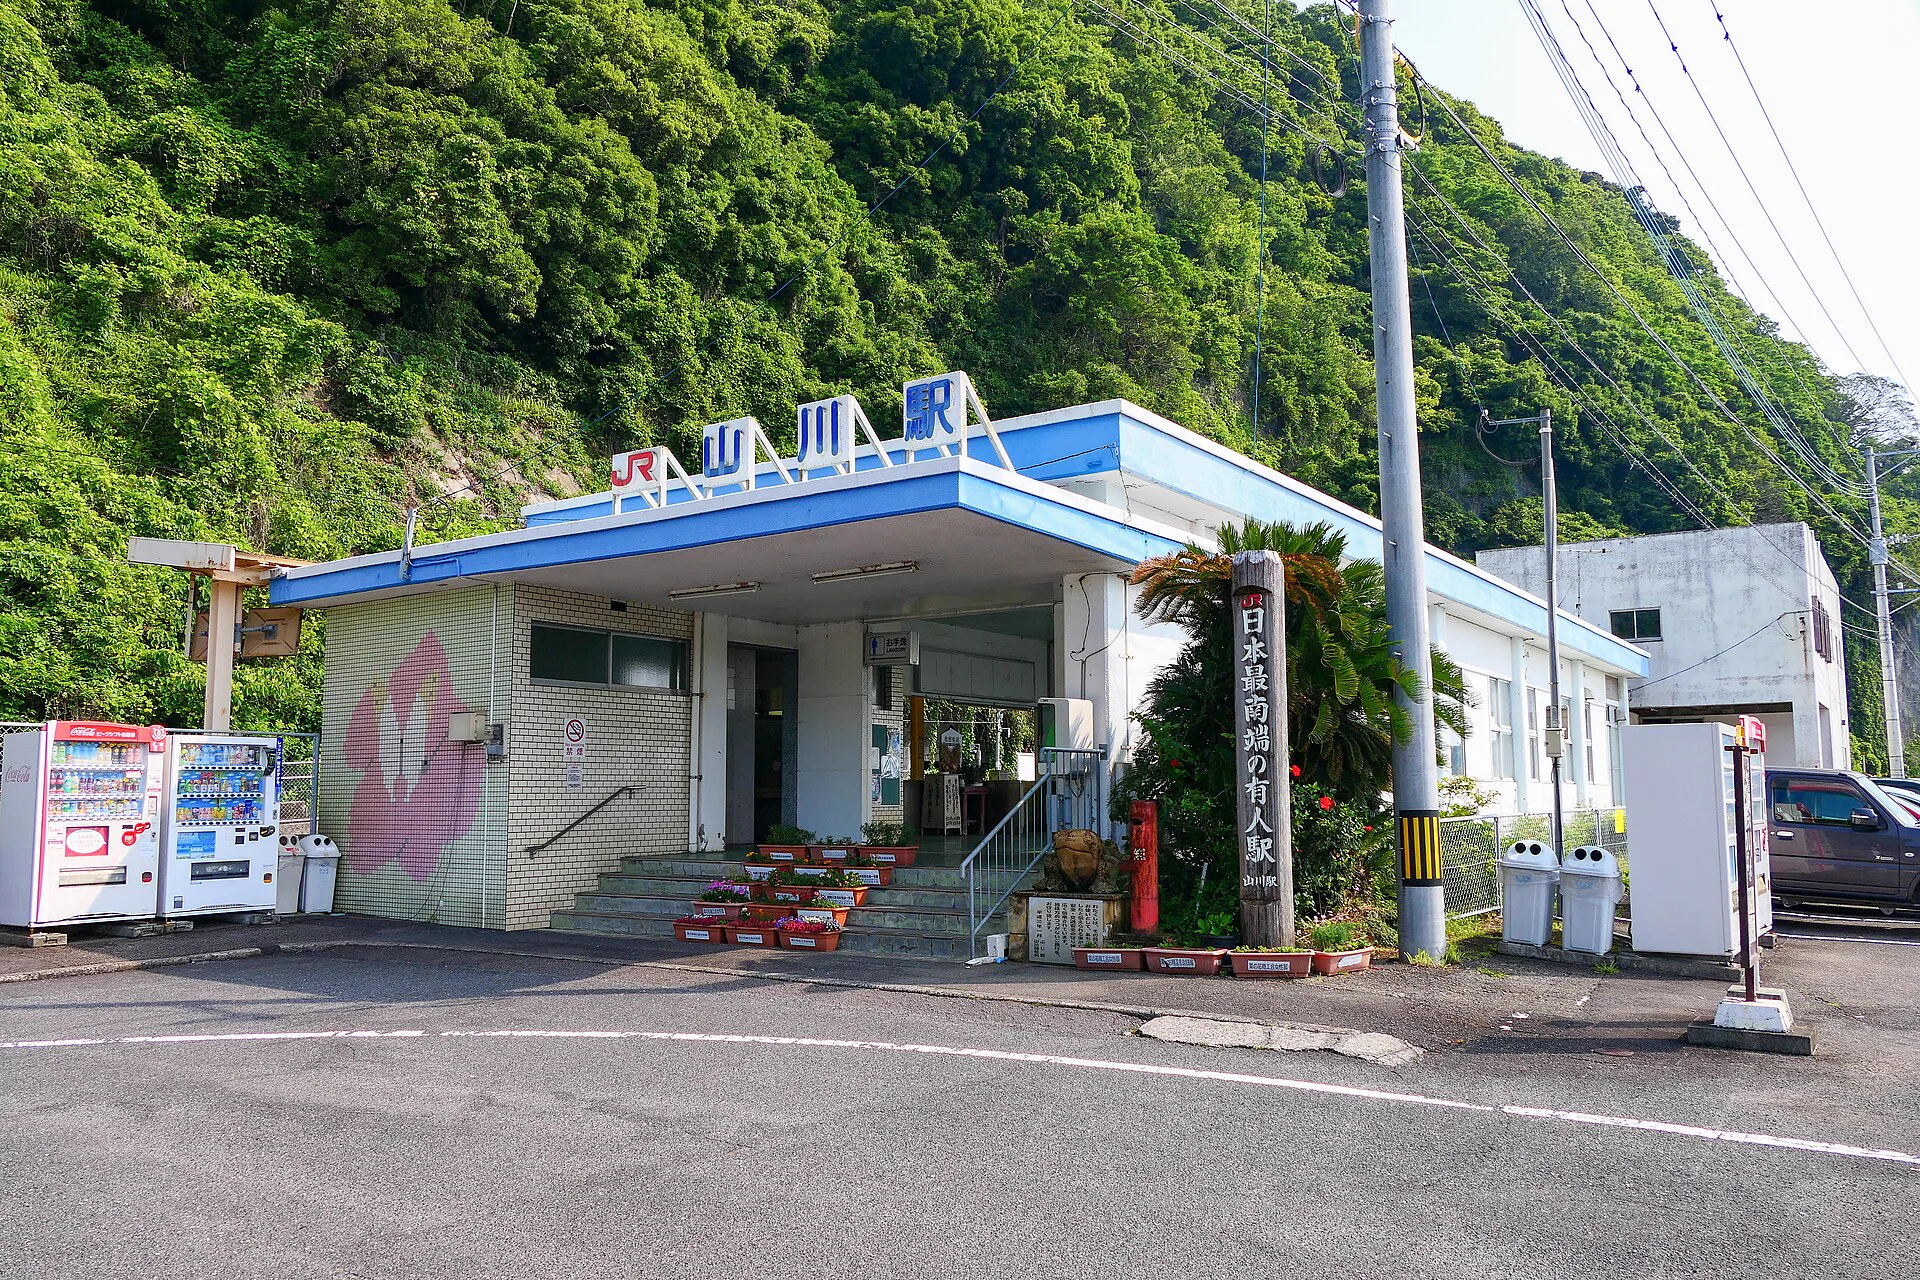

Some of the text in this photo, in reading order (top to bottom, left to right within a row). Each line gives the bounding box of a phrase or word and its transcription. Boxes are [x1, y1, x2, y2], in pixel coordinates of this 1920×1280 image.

[612, 378, 954, 487] JR 山川駅
[885, 637, 907, 647] お手洗
[70, 726, 96, 737] Coca-Cola
[1240, 593, 1276, 863] JR 日本最南端の有人駅
[566, 748, 584, 756] 禁煙
[5, 766, 31, 783] Coca-Cola
[1242, 874, 1279, 887] 山川駅
